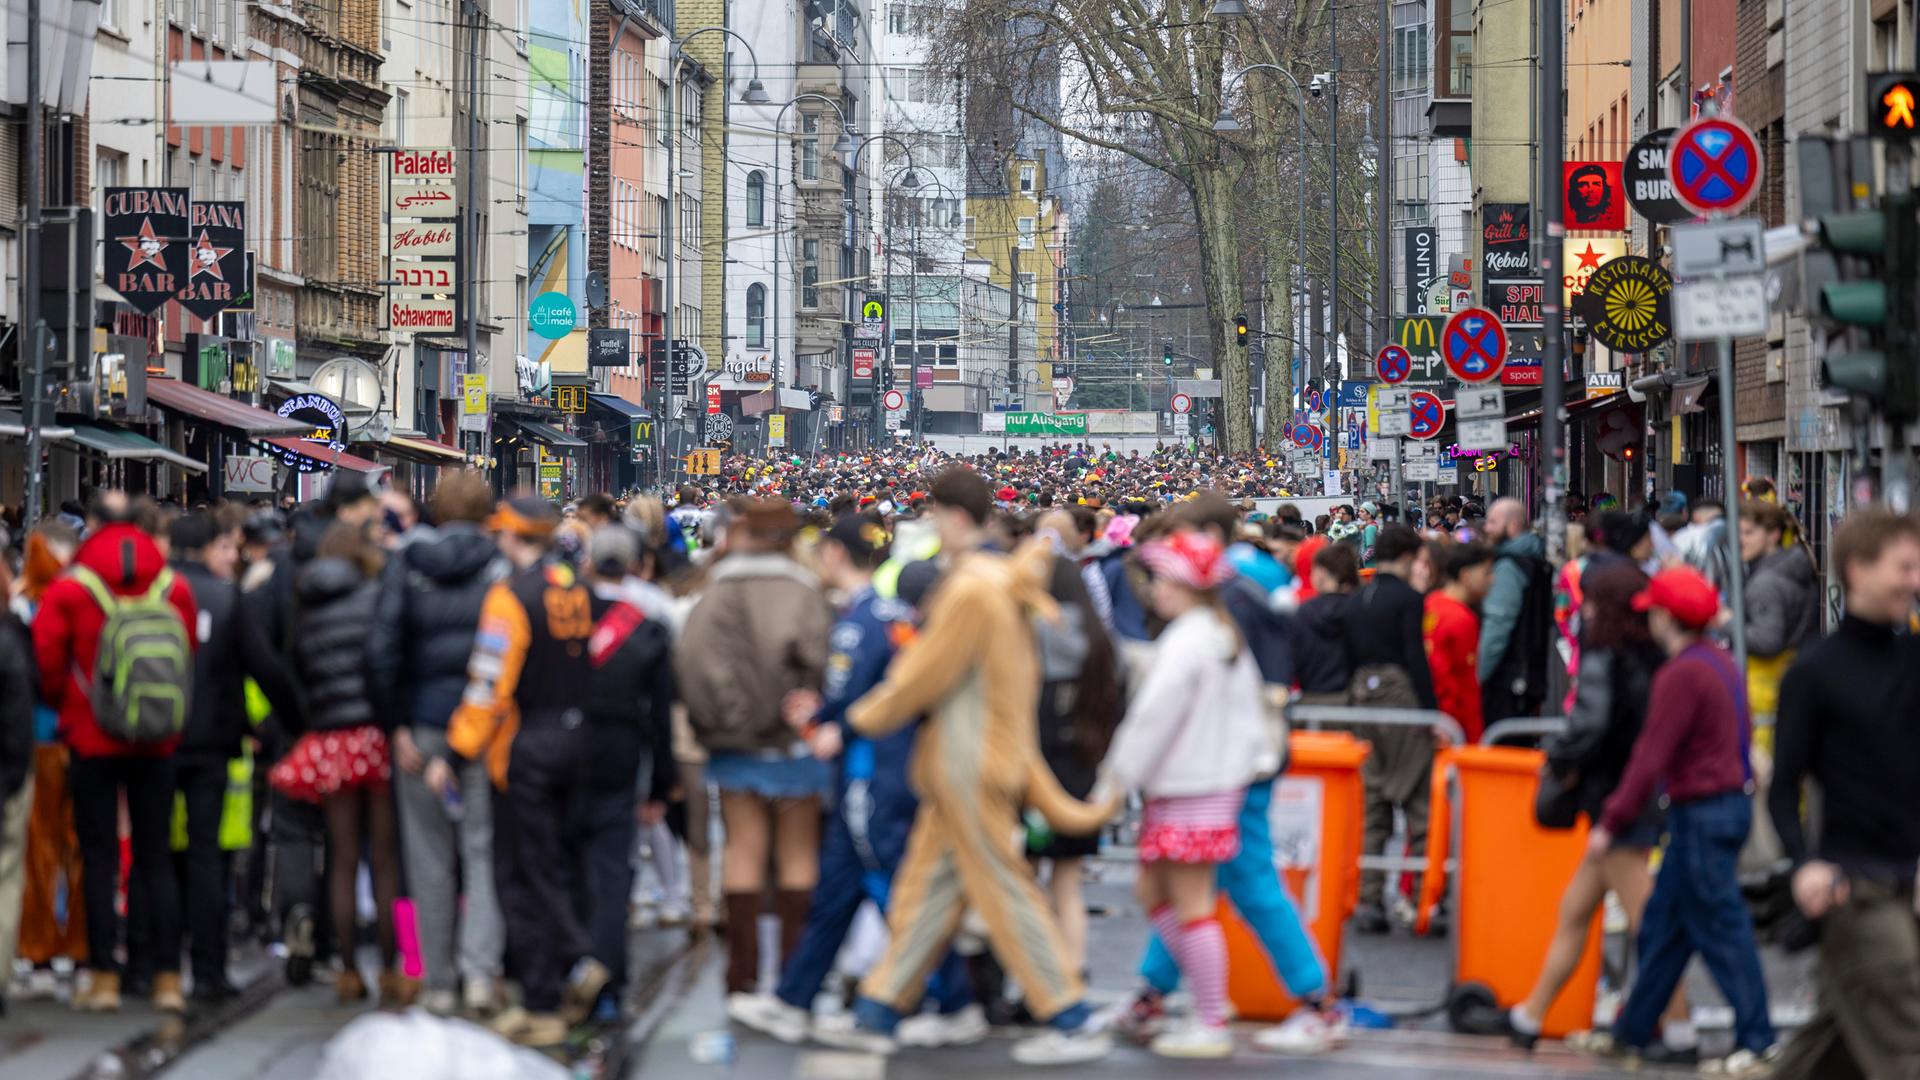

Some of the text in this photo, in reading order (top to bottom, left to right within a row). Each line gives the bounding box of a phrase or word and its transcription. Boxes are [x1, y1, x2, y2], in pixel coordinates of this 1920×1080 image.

[394, 151, 452, 174] Falafel
[105, 190, 188, 218] CUBANA
[395, 189, 452, 210] حبيبي
[192, 204, 244, 230] BANA
[1485, 251, 1529, 272] Kebab
[118, 273, 176, 292] BAR
[1589, 260, 1672, 296] RISTORANTE
[178, 282, 233, 300] BAR
[392, 304, 453, 327] Schawarma
[551, 307, 572, 316] café
[1509, 370, 1537, 381] sport
[1588, 374, 1621, 386] ATM
[1007, 416, 1028, 425] nur
[1030, 414, 1085, 428] Ausgang
[227, 459, 270, 485] WC
